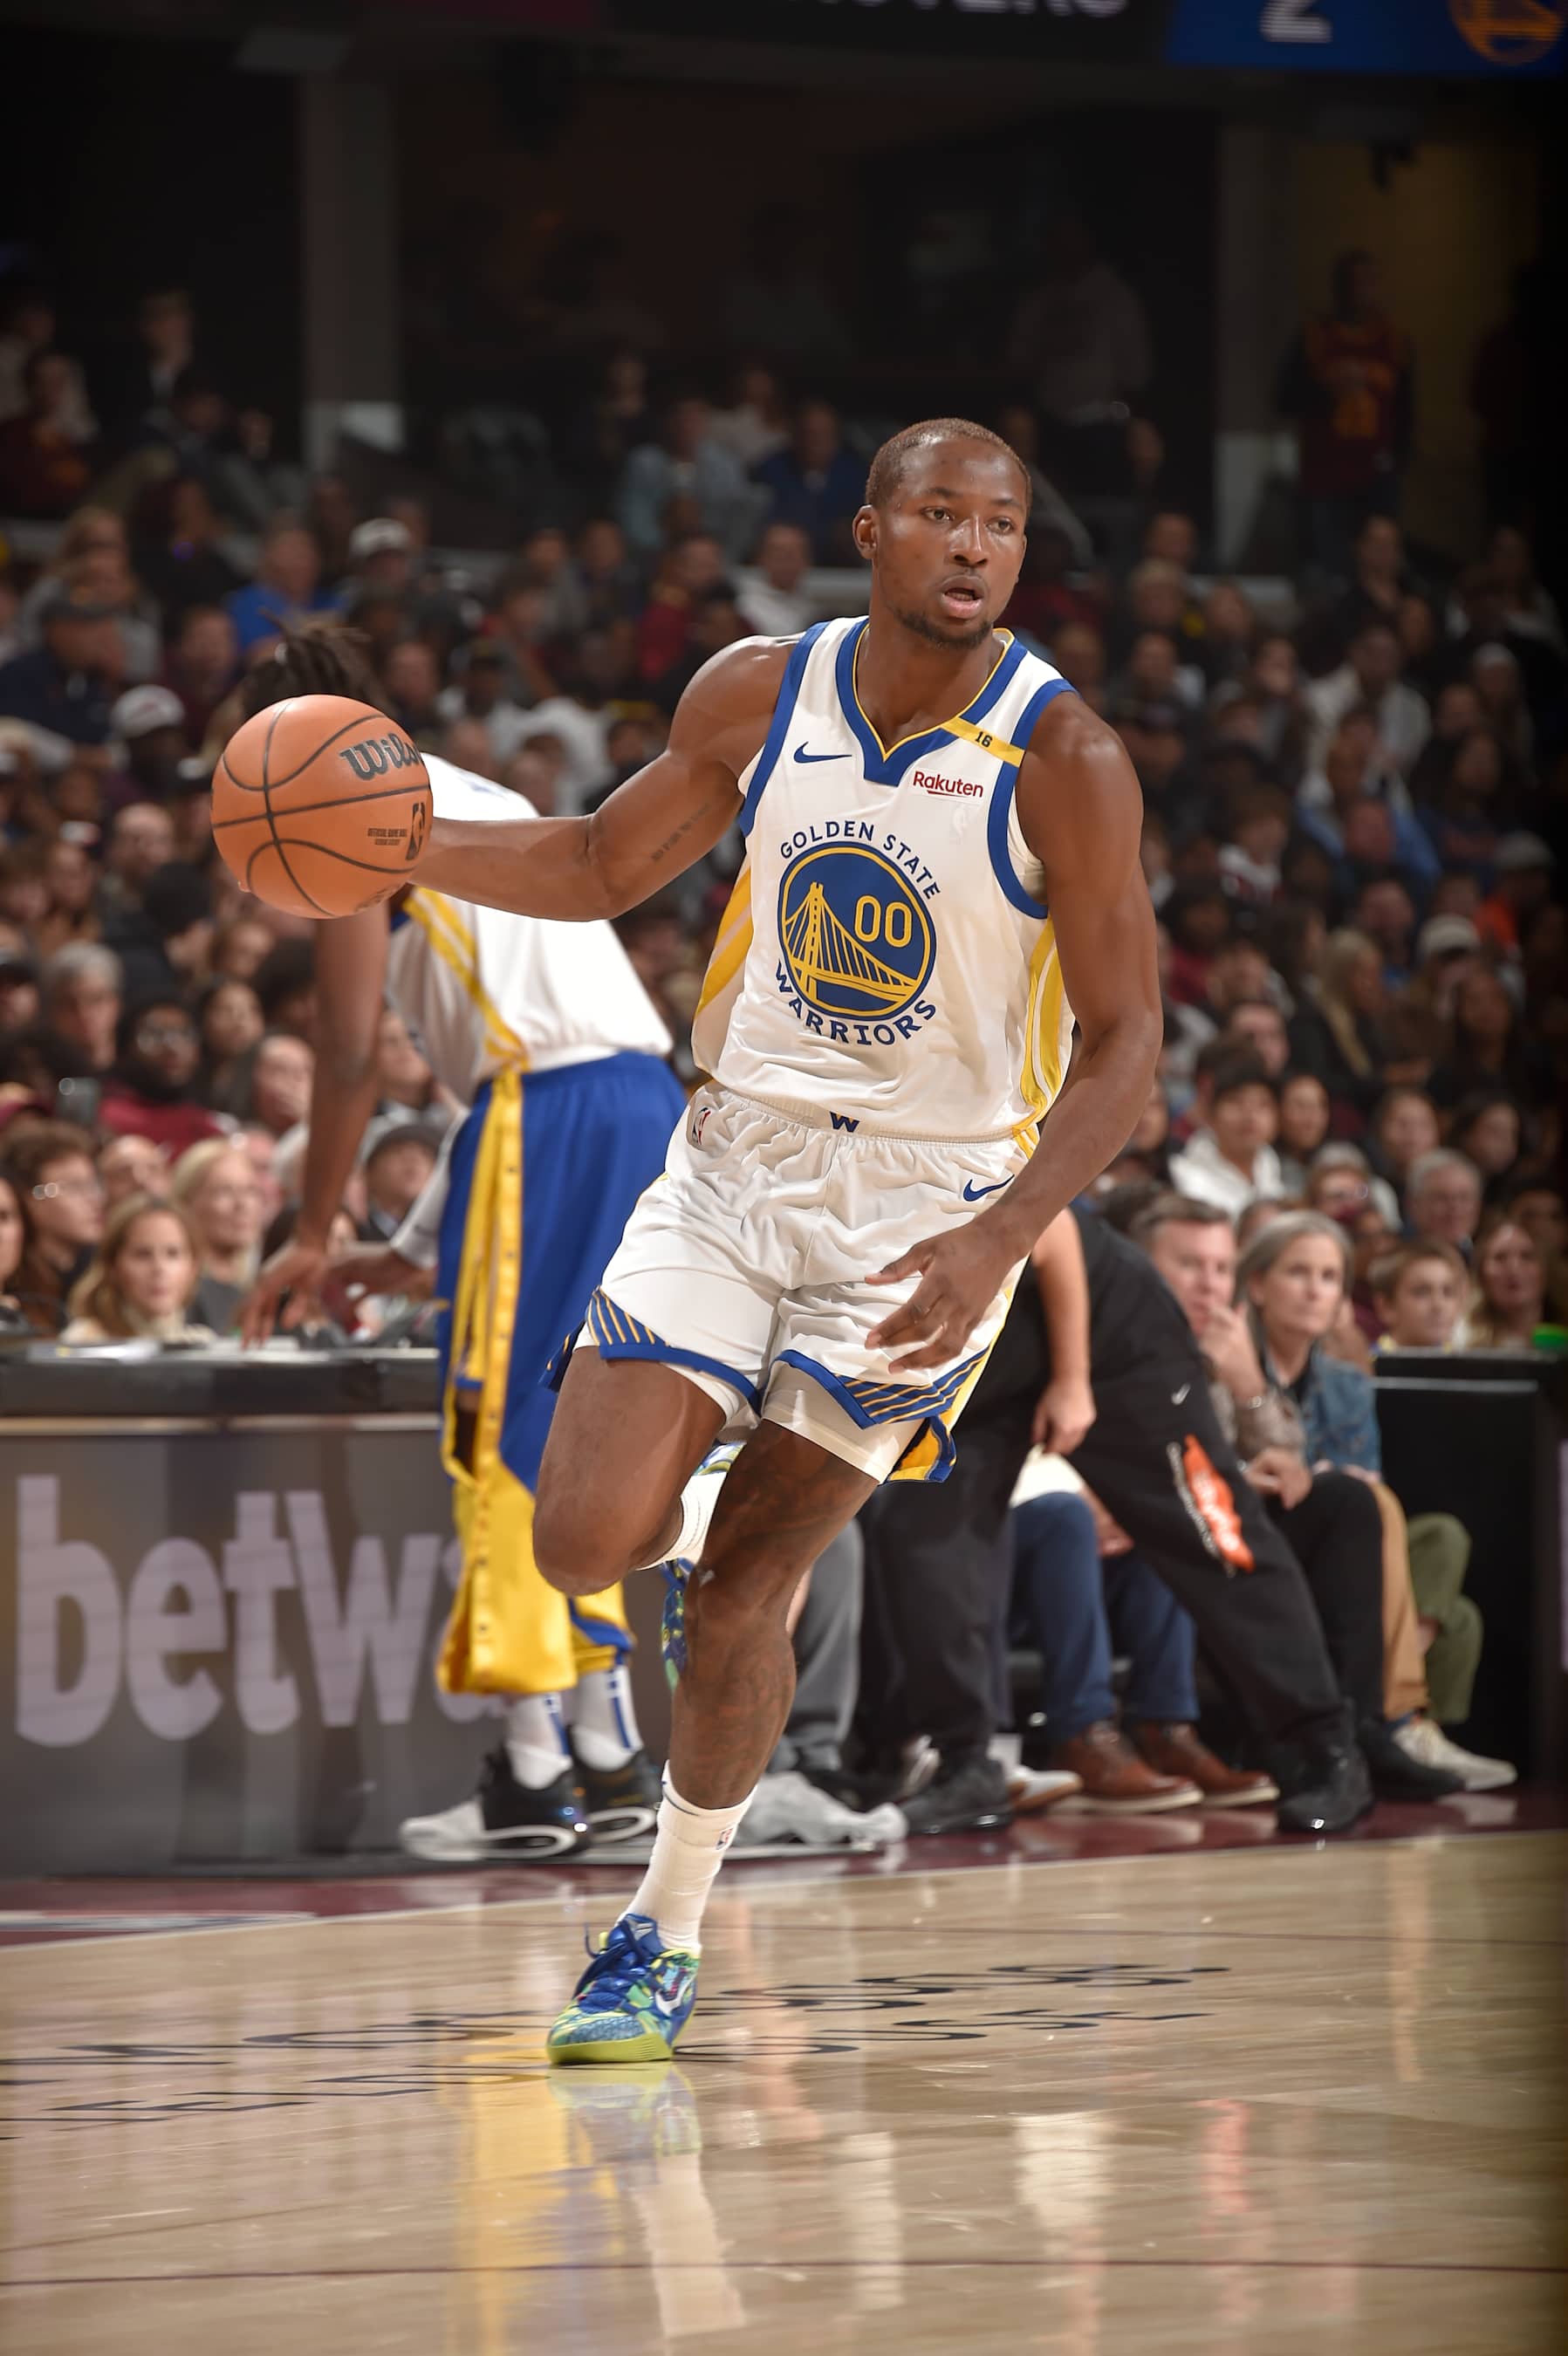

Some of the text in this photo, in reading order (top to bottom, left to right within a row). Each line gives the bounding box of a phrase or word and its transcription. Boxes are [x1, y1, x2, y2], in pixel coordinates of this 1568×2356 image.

[975, 731, 993, 748] 16
[913, 770, 984, 798] Rakuten
[780, 820, 941, 900] GOLDEN STATE
[854, 894, 913, 949] 00
[776, 959, 936, 1045] WARRIORS
[830, 1110, 860, 1133] W
